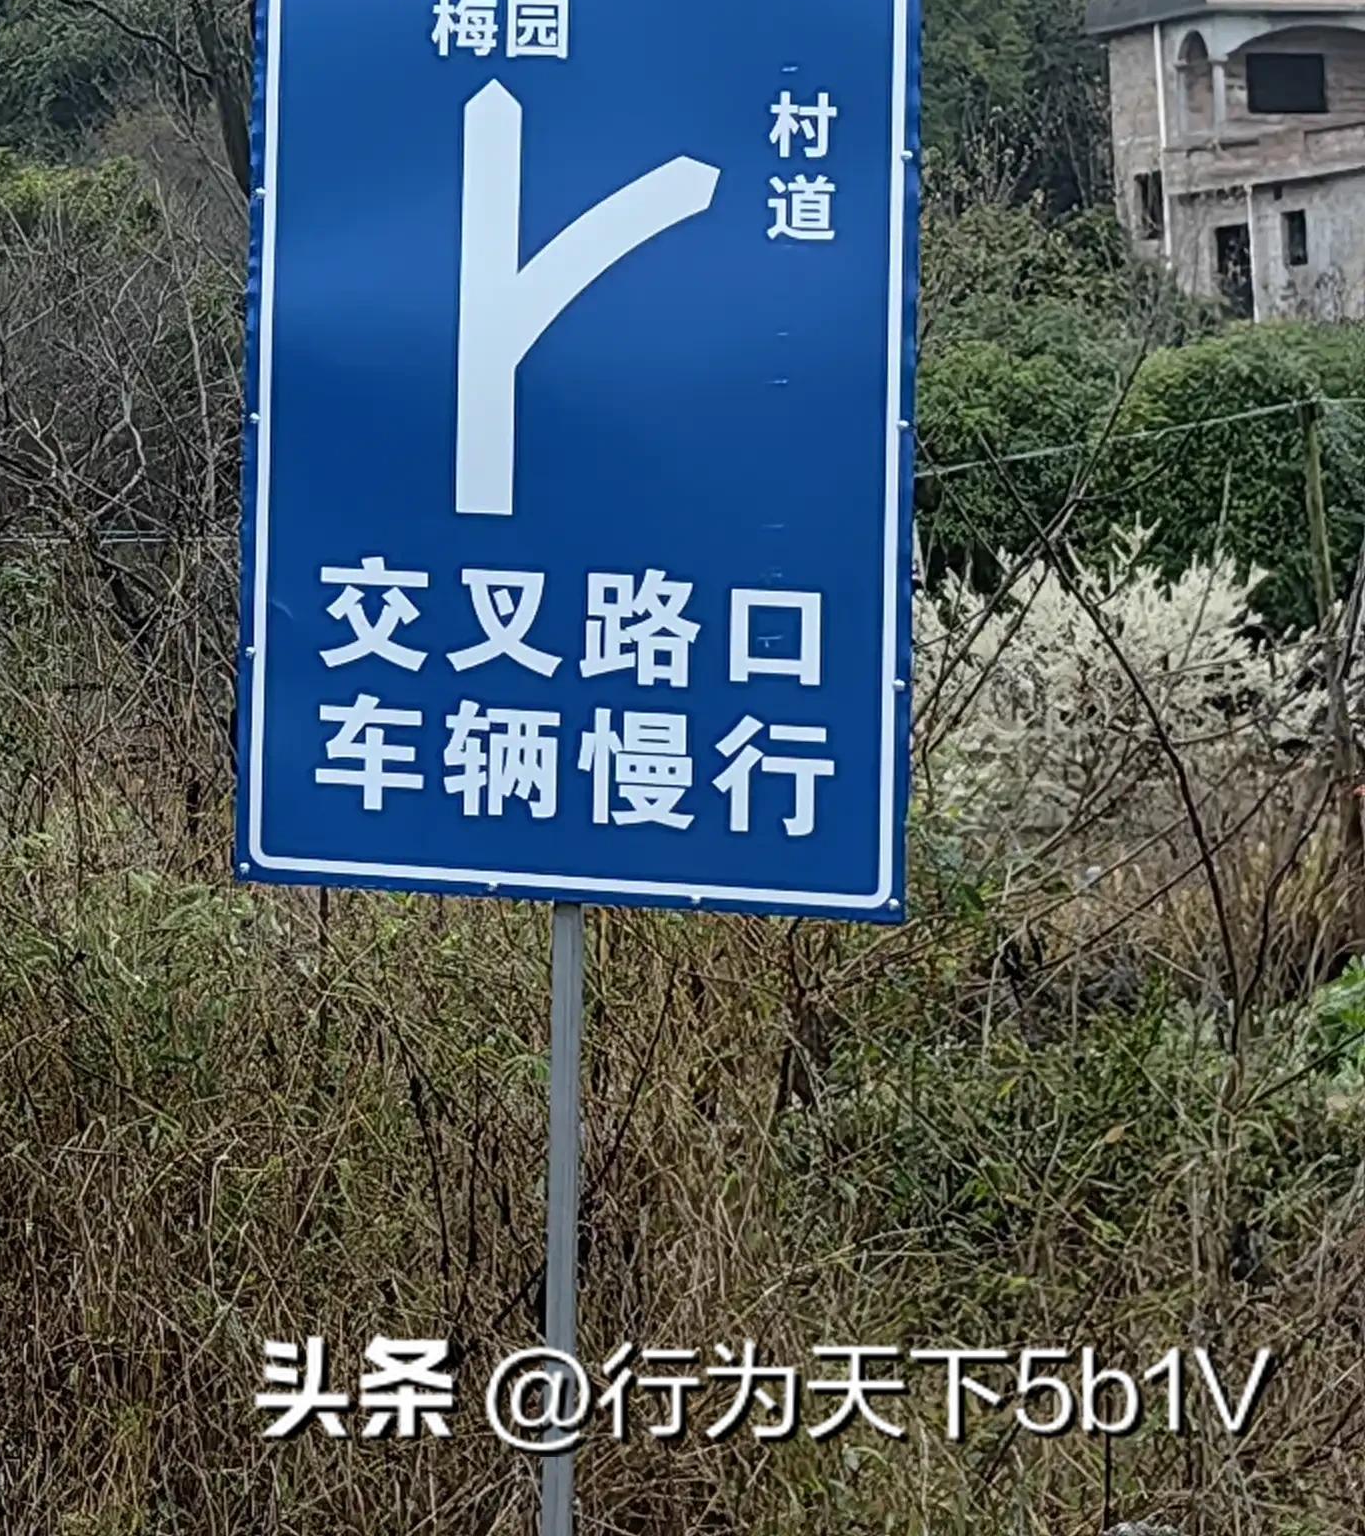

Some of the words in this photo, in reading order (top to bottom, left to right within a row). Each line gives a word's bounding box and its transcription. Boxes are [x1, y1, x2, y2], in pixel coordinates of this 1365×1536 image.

[766, 92, 839, 240] 村道
[317, 555, 822, 687] 交叉路口
[314, 694, 836, 836] 车辆慢行
